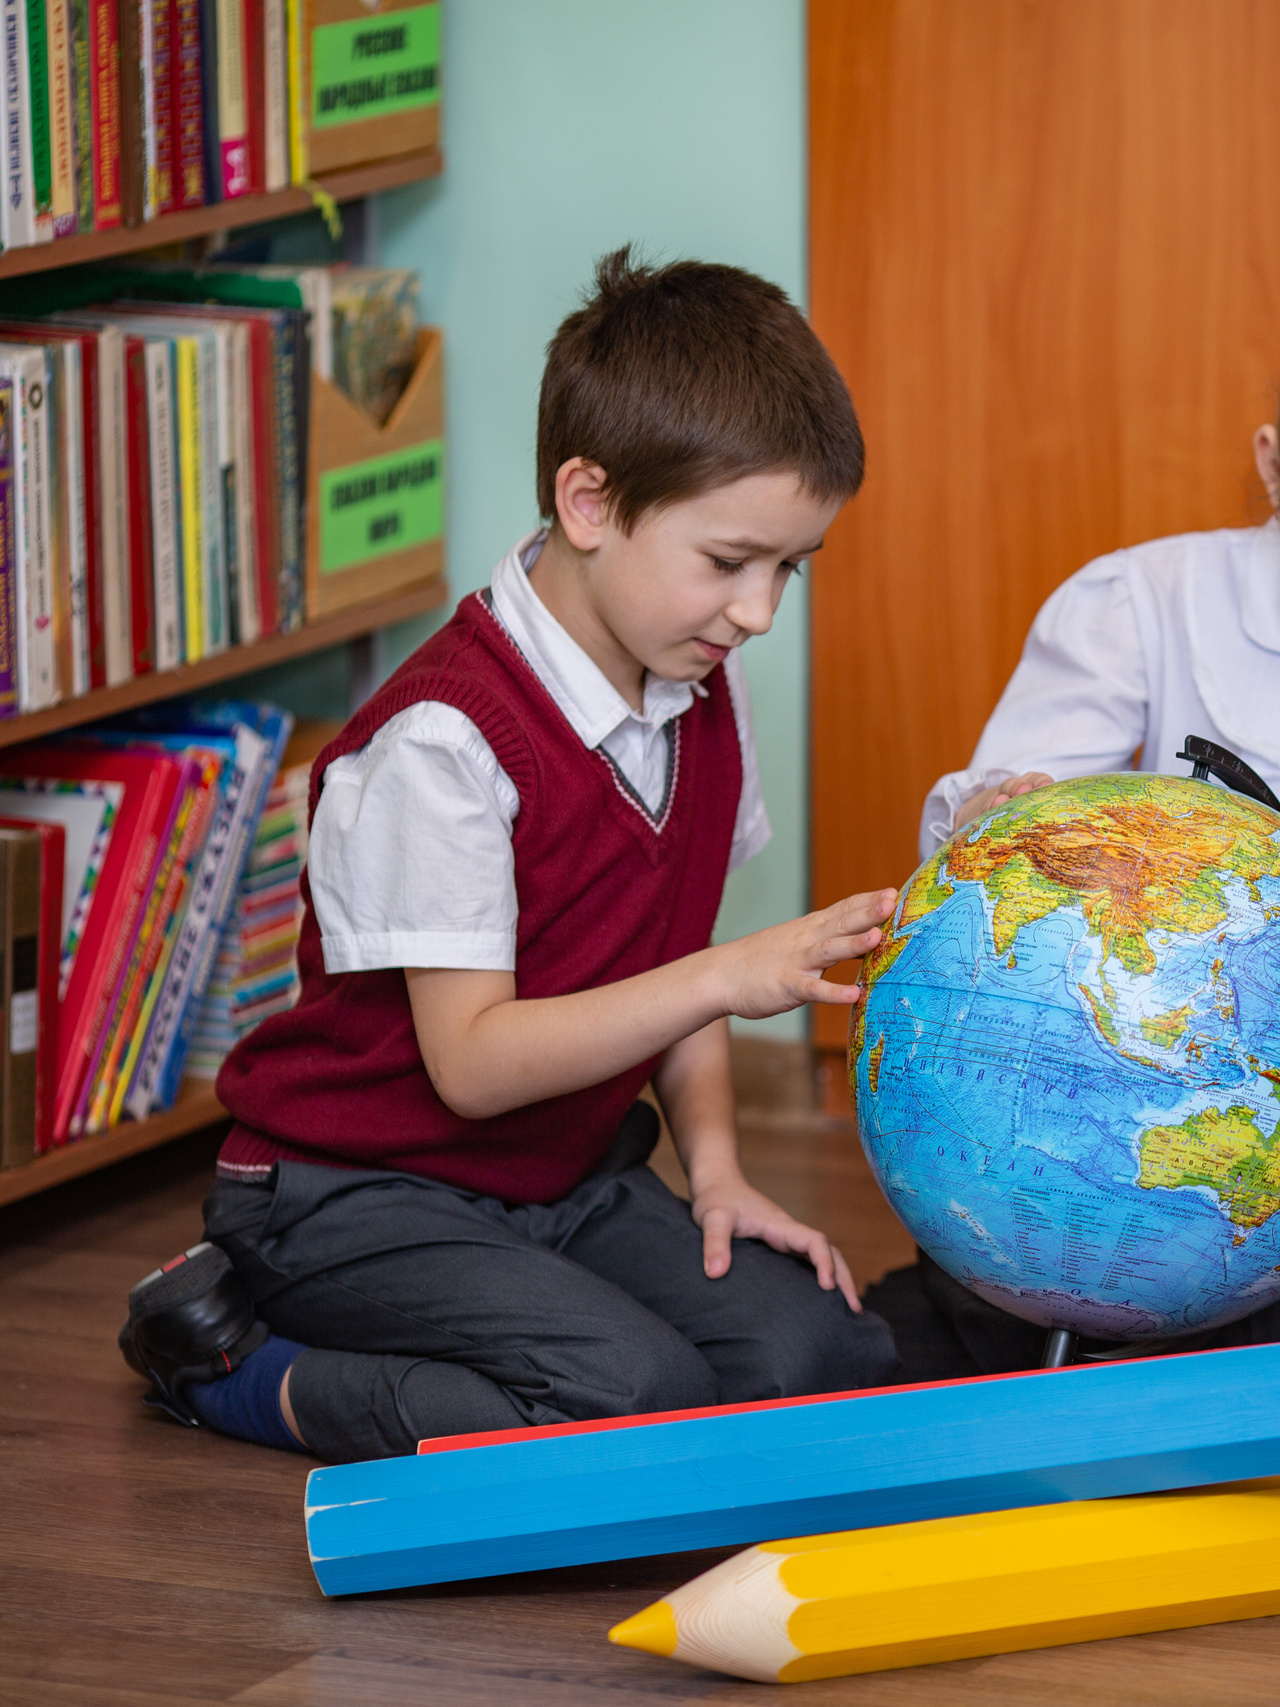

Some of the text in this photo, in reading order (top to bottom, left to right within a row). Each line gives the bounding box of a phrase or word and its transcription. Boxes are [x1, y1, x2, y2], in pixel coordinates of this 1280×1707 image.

[5, 13, 21, 172] ВЕЛИКИЕ СКАЗОЧНИКИ
[53, 58, 70, 187] ЛЮБИМЫЕ
[138, 925, 198, 1094] РУССКИЕ
[194, 769, 247, 919] СКАЗКИ
[903, 1058, 1077, 1099] ИНДИЙСКИЙ
[937, 1146, 1044, 1176] ОКЕАН
